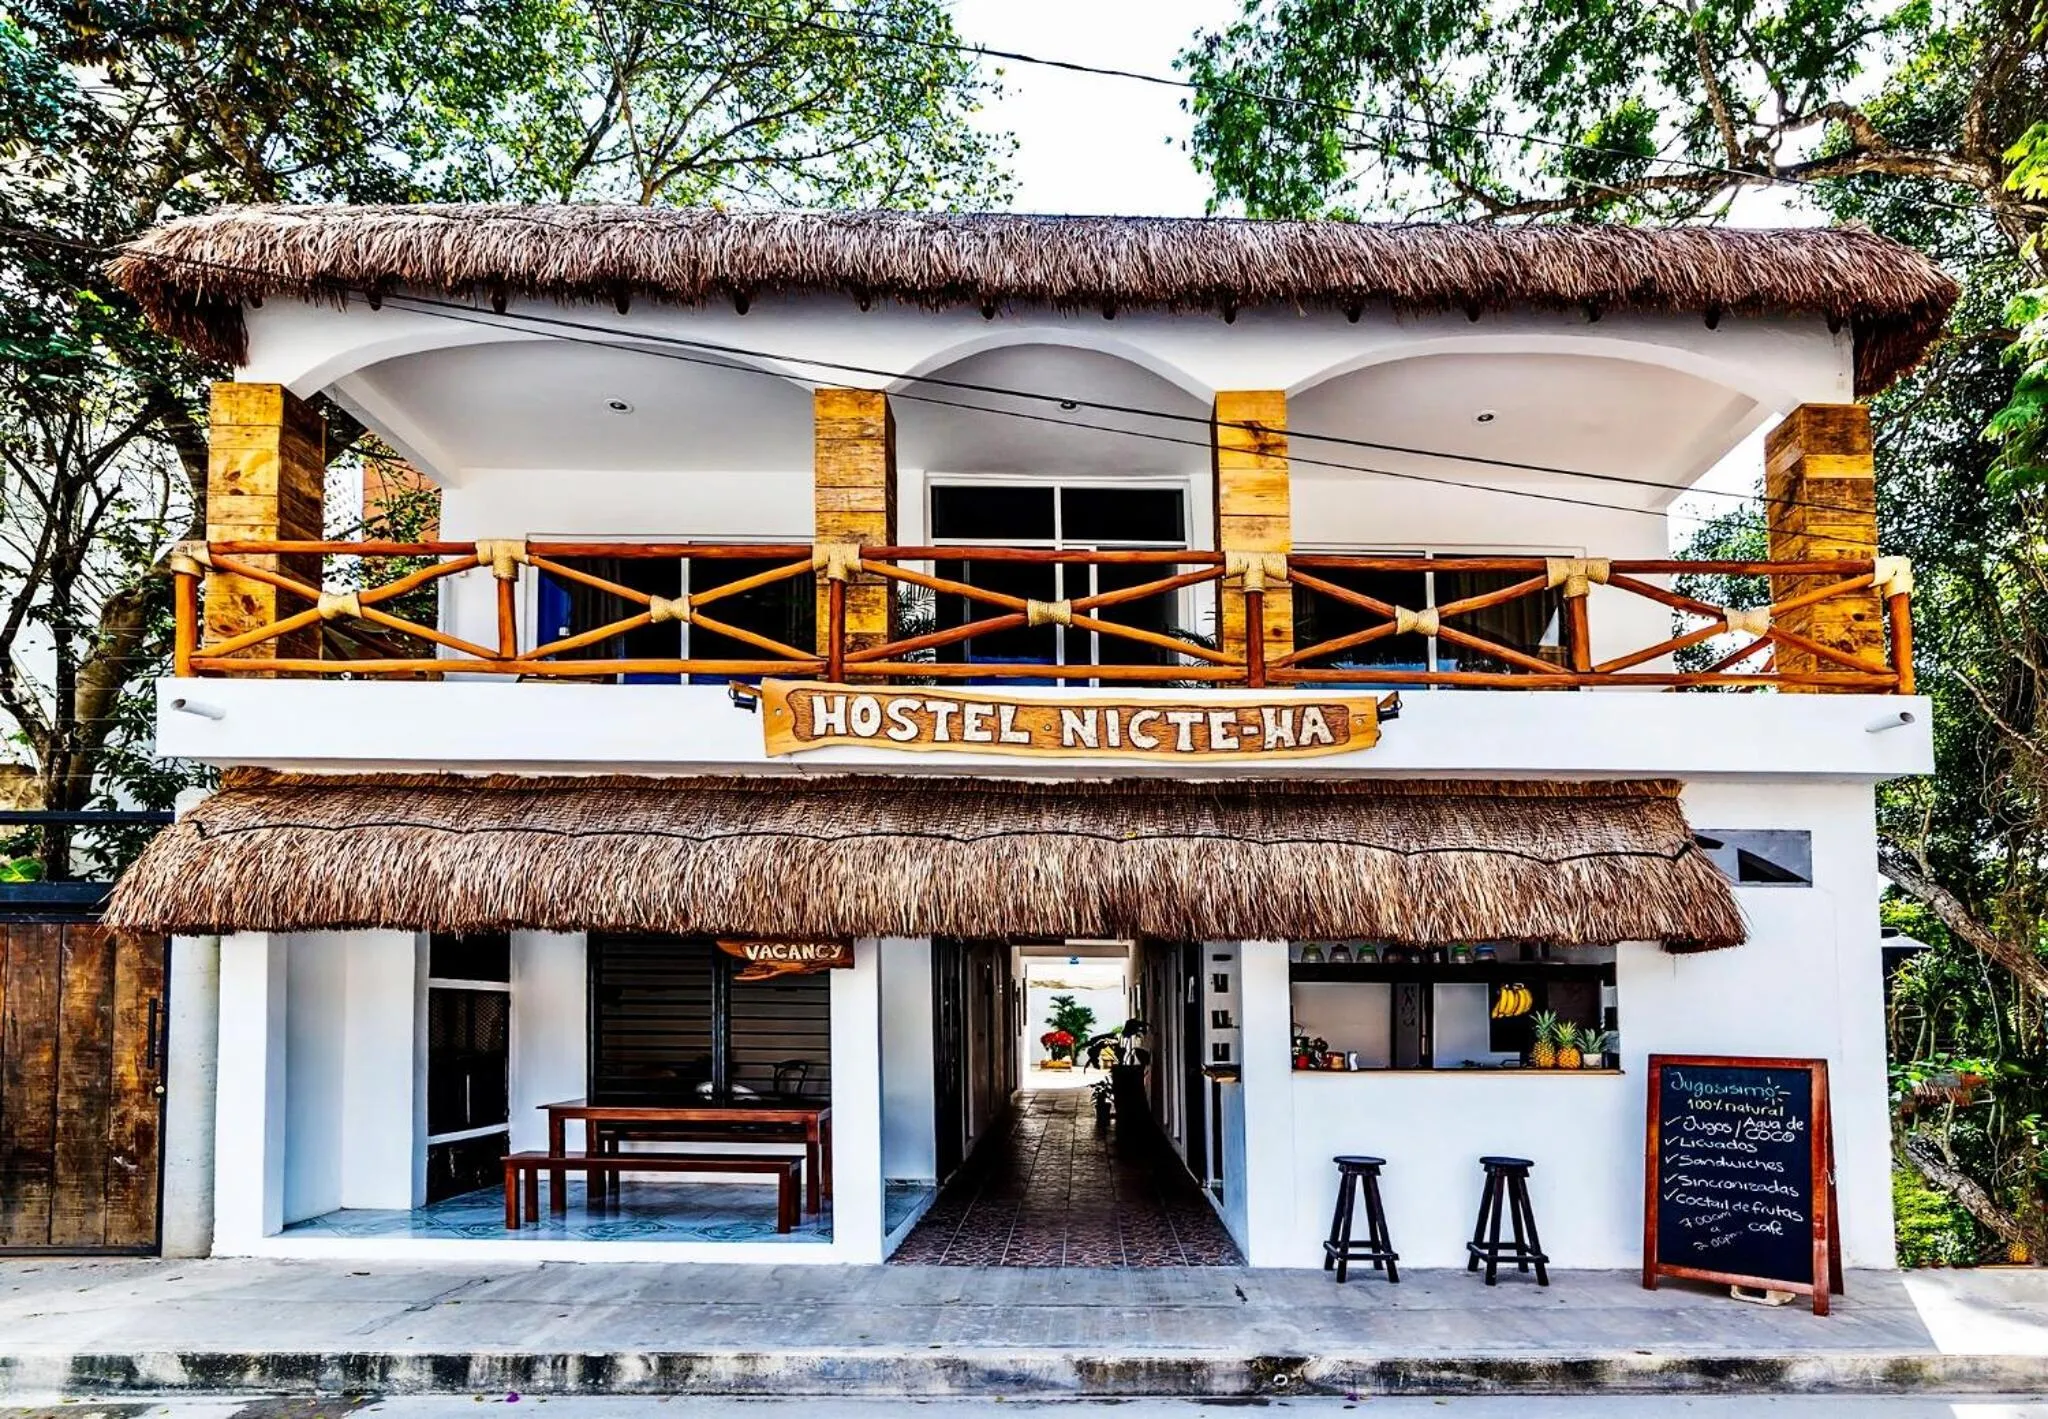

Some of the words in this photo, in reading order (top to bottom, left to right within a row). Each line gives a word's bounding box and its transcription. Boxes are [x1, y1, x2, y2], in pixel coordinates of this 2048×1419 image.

[811, 694, 1032, 744] HOSTEL
[1060, 704, 1335, 752] NICTE-HA
[746, 943, 843, 961] VACANCY
[1725, 1102, 1784, 1117] natural
[1683, 1115, 1732, 1136] Jugos
[1743, 1117, 1781, 1132] Agua
[1786, 1116, 1804, 1131] de
[1680, 1137, 1758, 1154] Licuados
[1678, 1154, 1784, 1173] Sandwiches
[1678, 1175, 1800, 1198] Sincronizadas
[1732, 1201, 1750, 1213] de
[1752, 1201, 1804, 1223] frutas
